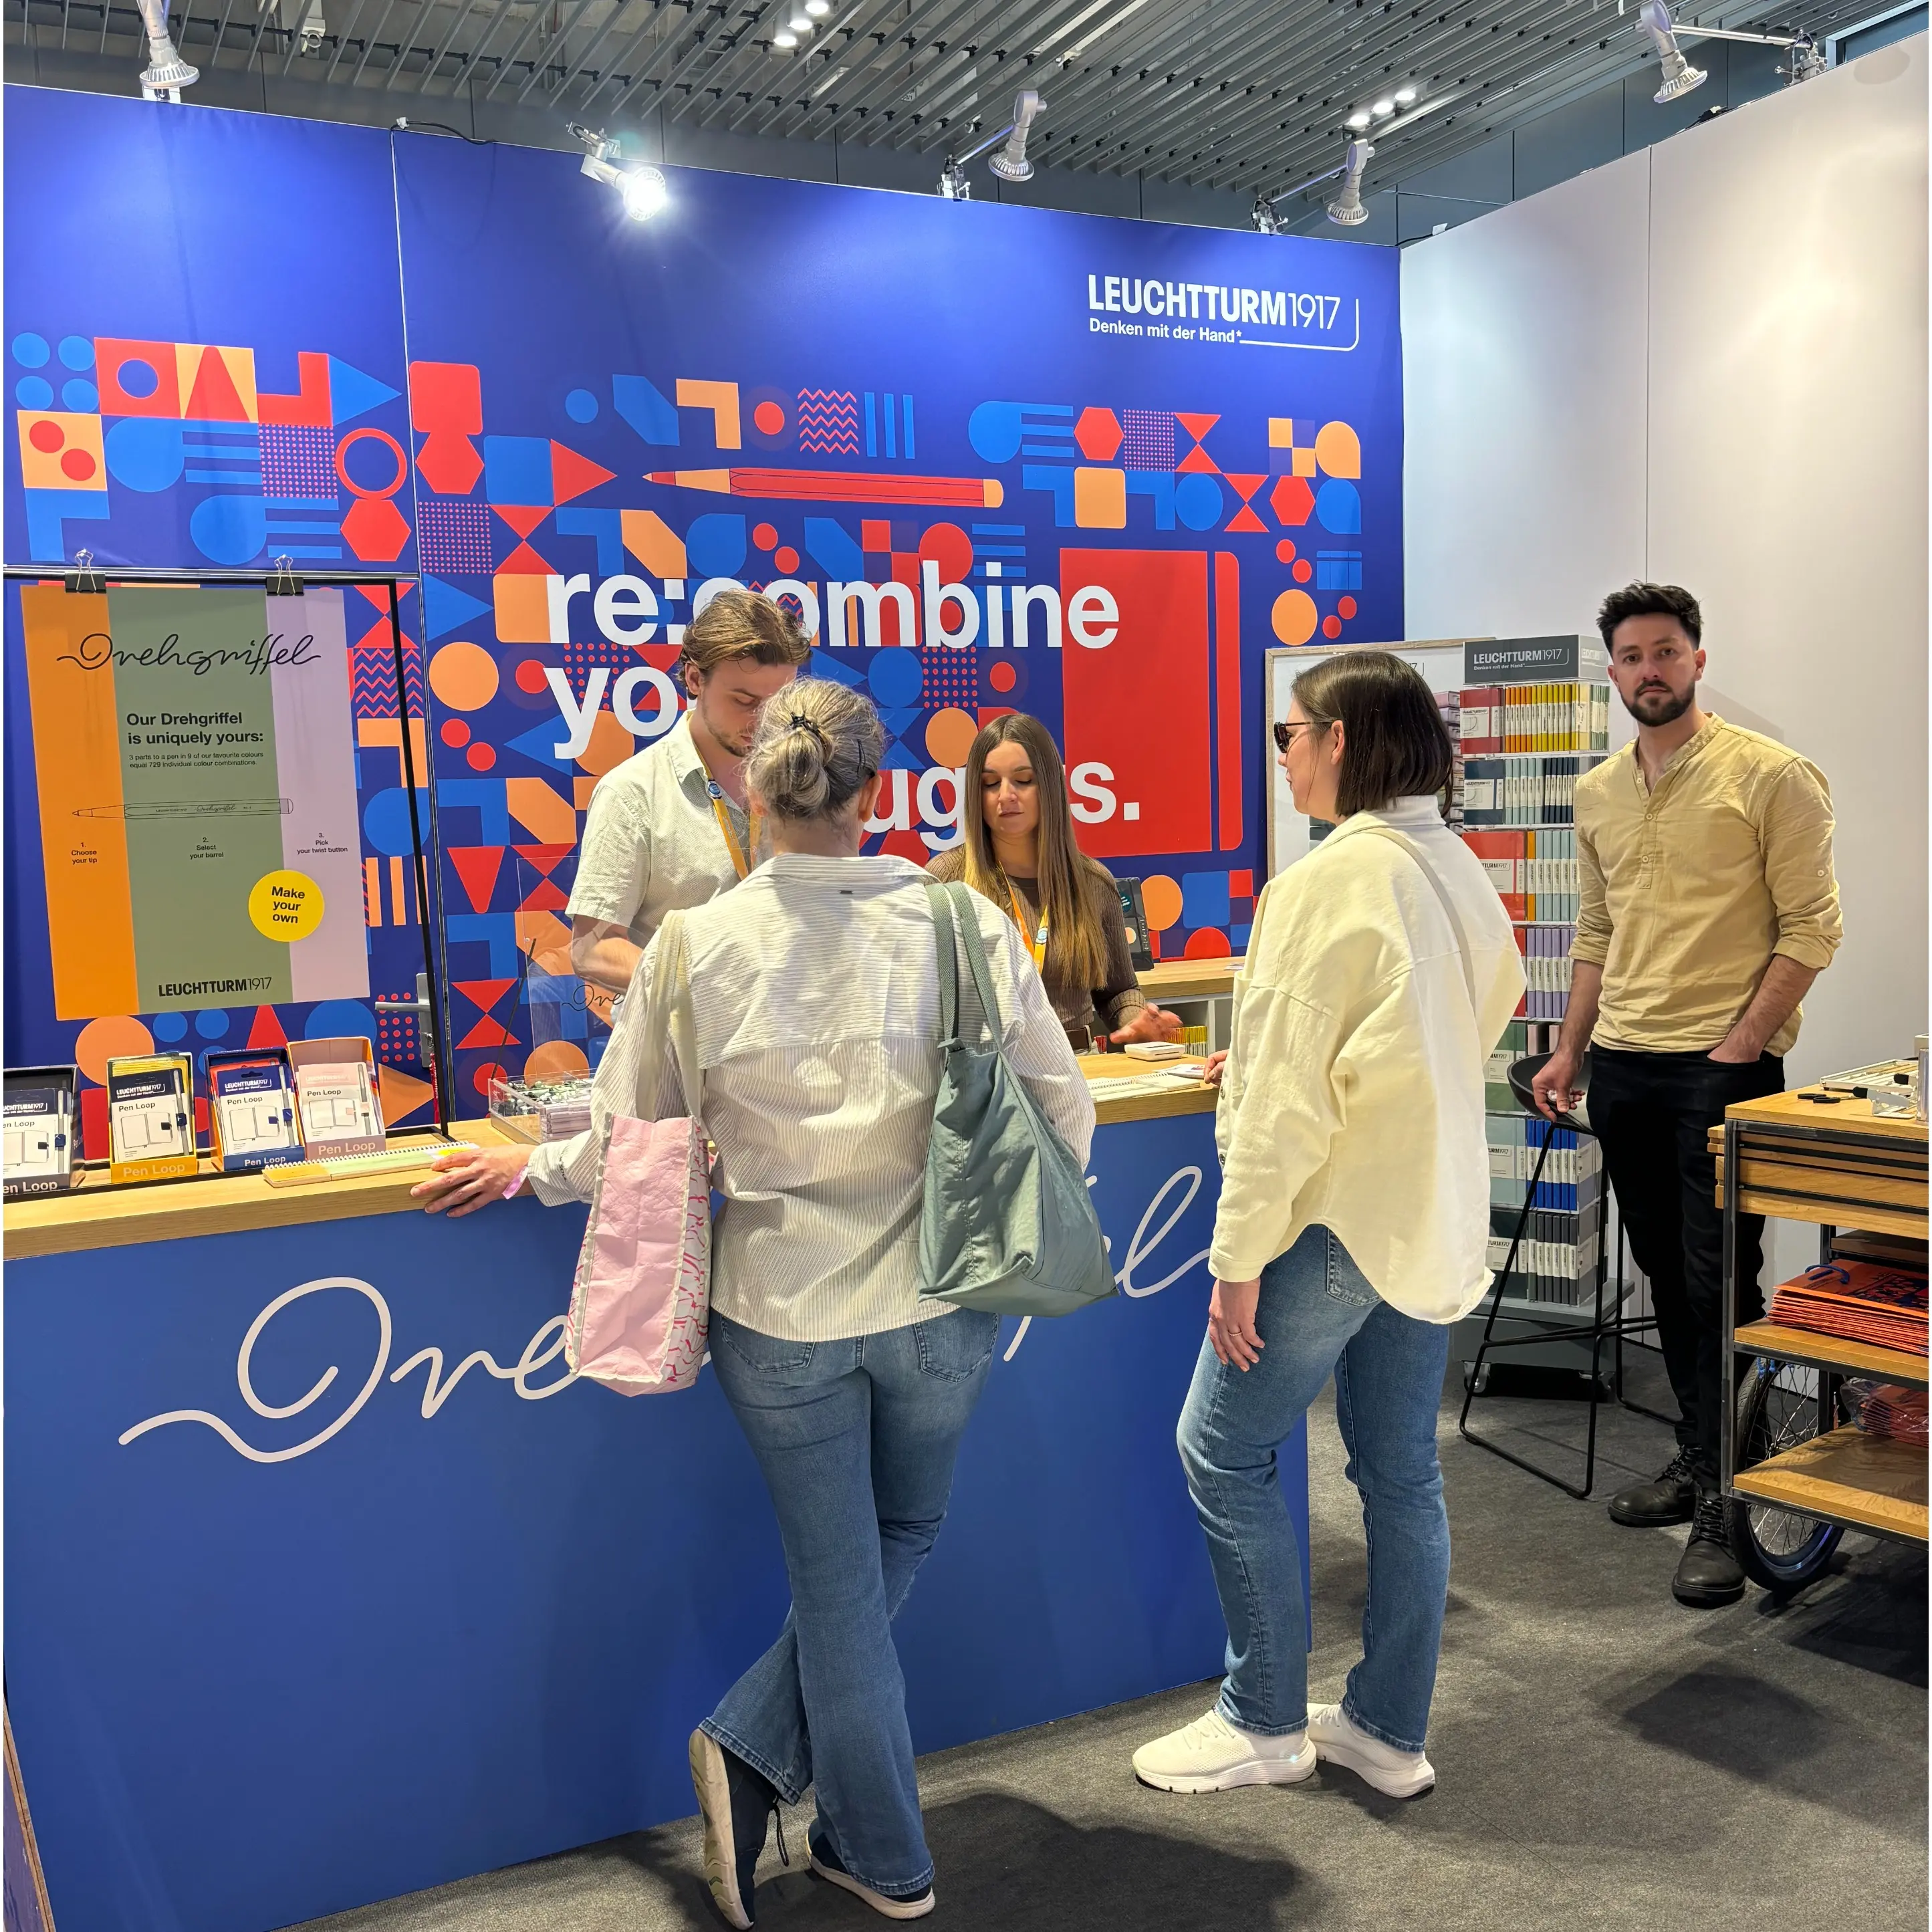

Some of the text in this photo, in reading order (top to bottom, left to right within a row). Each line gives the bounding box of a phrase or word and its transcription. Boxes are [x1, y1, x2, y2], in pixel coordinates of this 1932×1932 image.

[1088, 274, 1341, 330] LEUCHTTURM1917
[1090, 318, 1143, 336] Denken
[1147, 324, 1170, 338] mit
[1173, 325, 1196, 340] der
[1473, 648, 1562, 665] LEUCHTTURM1917
[126, 712, 243, 727] Our Drehgriffel
[128, 731, 263, 745] is uniquely yours:
[271, 886, 306, 899] Make
[273, 901, 301, 911] your
[273, 913, 298, 924] own
[158, 977, 272, 997] LEUCHTTURM1917
[318, 1142, 376, 1155] Pen Loop
[245, 1156, 286, 1167] Pen Loop
[123, 1163, 185, 1177] Pen Loop
[3, 1181, 58, 1194] en Loop
